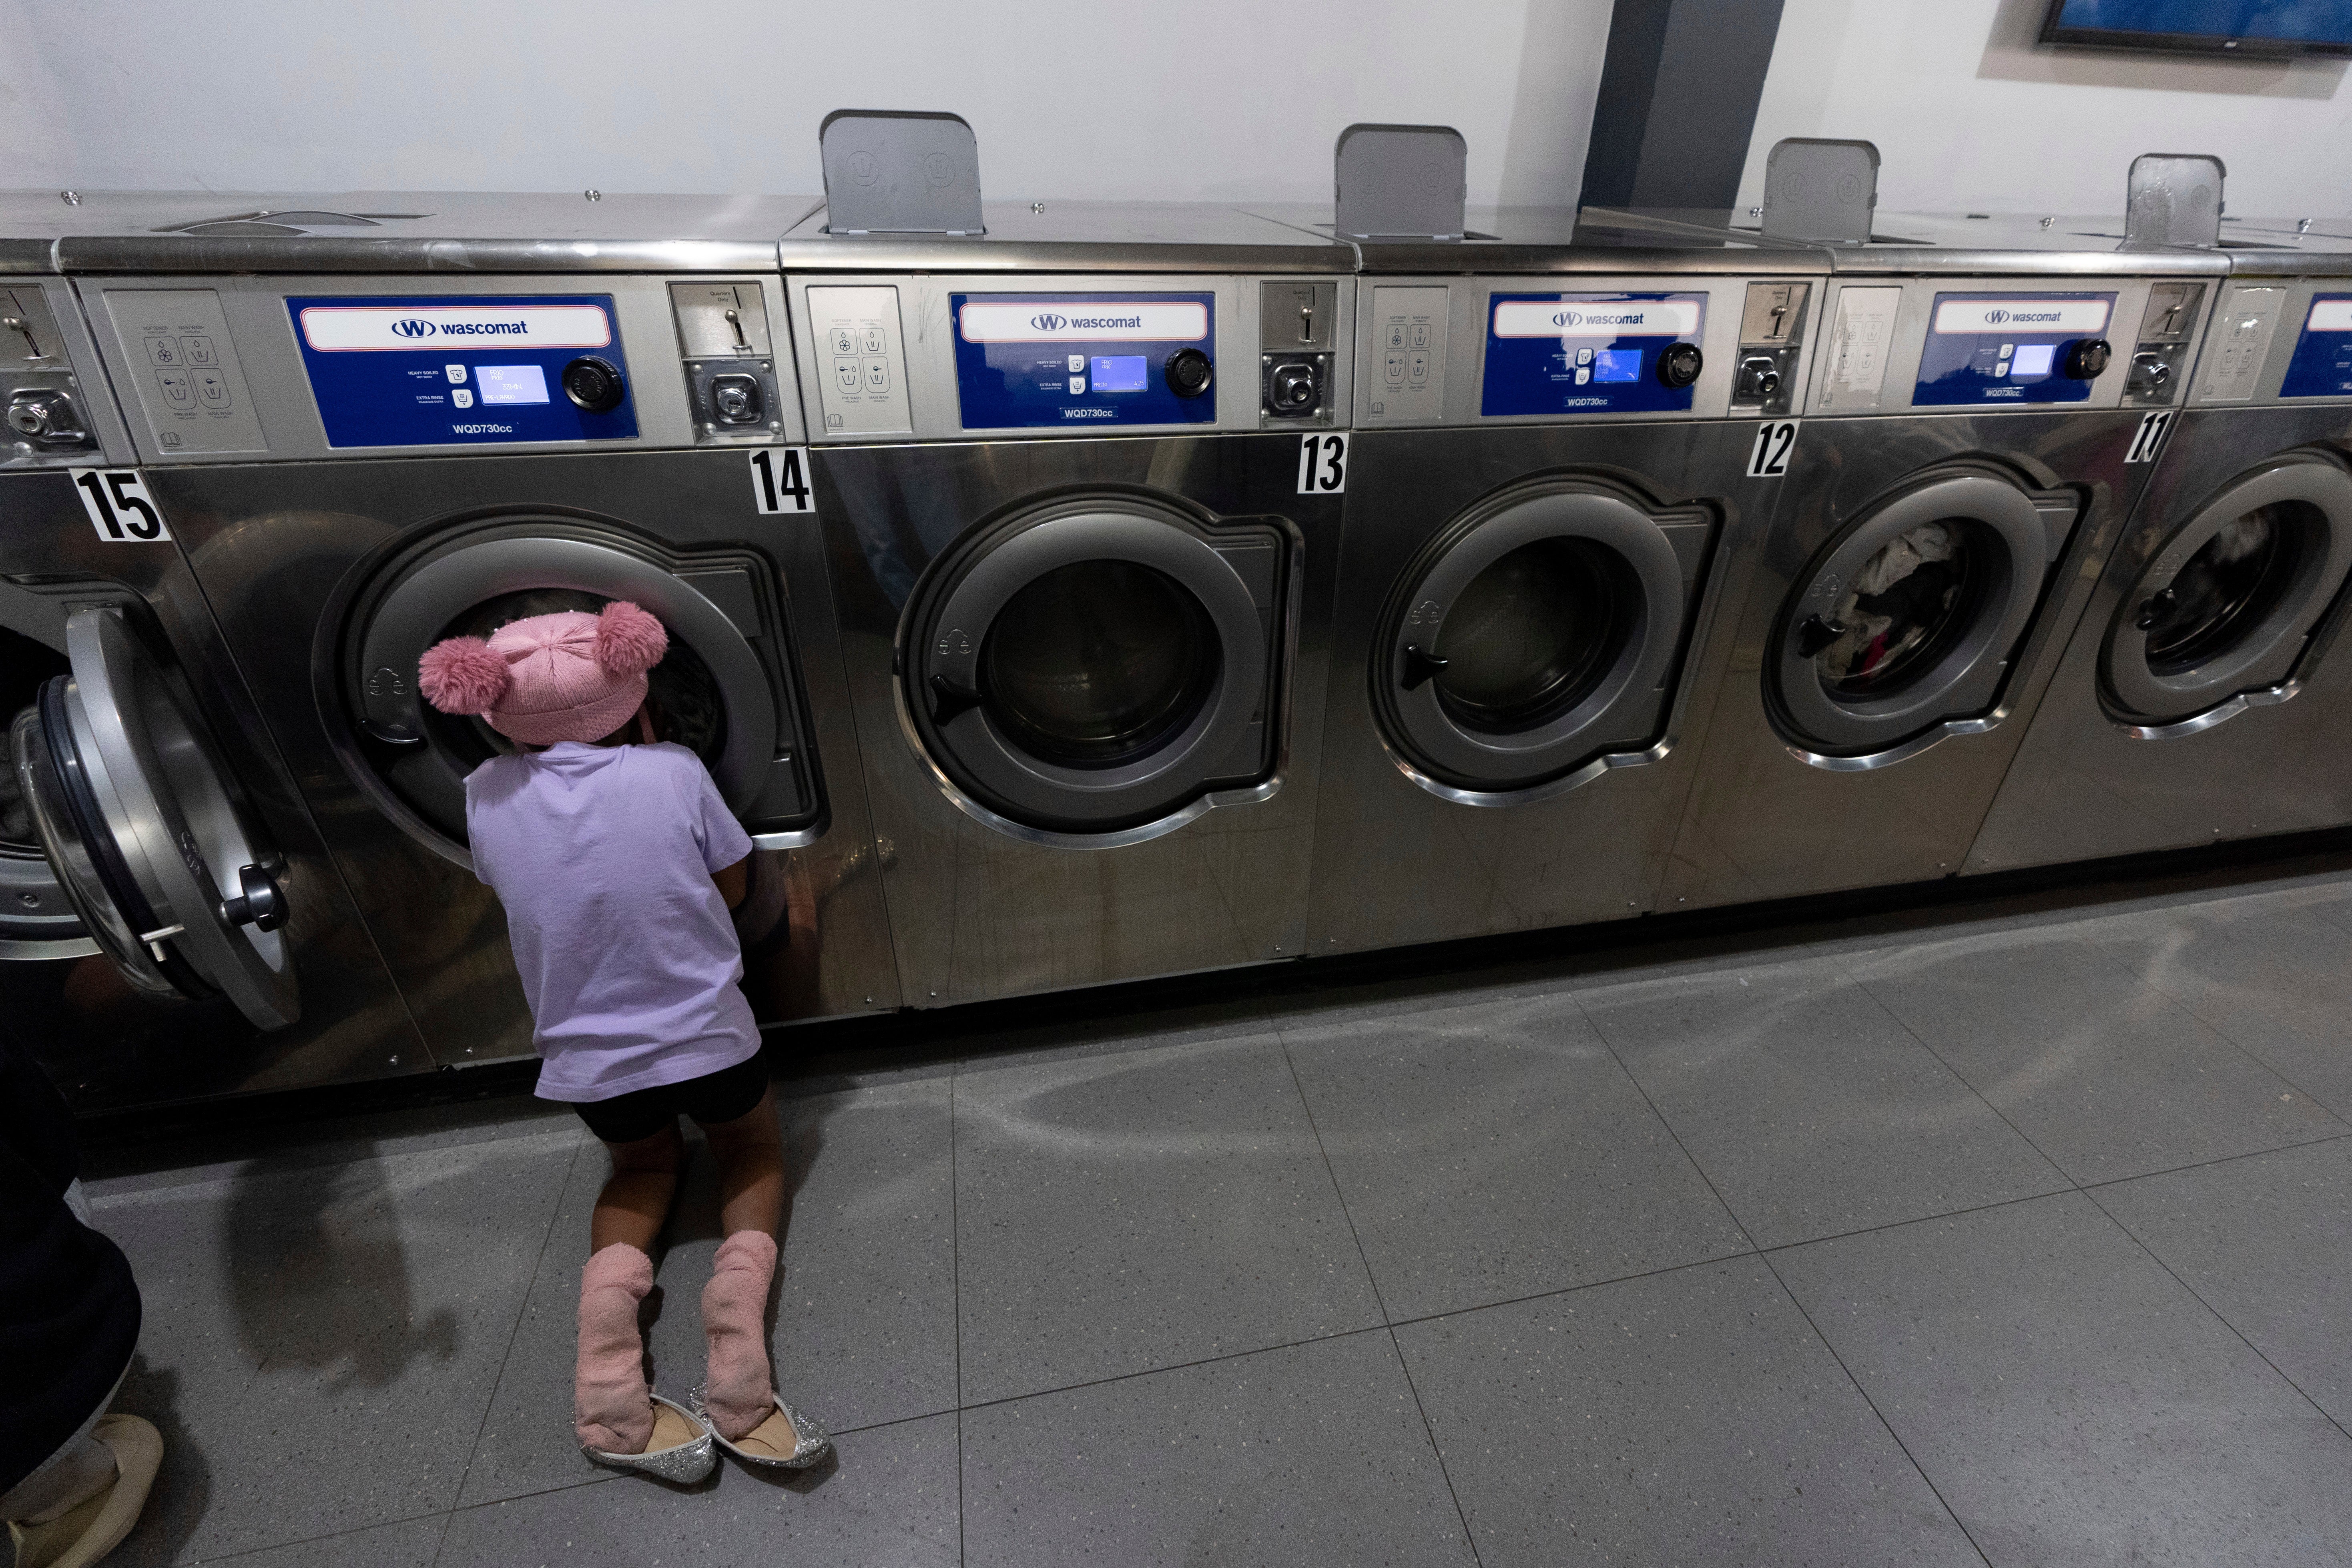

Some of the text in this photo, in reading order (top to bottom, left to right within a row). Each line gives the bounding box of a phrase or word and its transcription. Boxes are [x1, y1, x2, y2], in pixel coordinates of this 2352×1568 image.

[1071, 316, 1141, 328] wascomat
[1586, 313, 1644, 324] wascomat
[2013, 312, 2061, 321] wascomat
[441, 321, 528, 335] wascomat
[1568, 398, 1607, 406] WQD730cc
[1064, 409, 1113, 418] WQD730cc
[452, 424, 512, 434] WQD730cc
[2131, 413, 2171, 460] 11
[1753, 423, 1796, 474] 12
[1304, 436, 1344, 492] 13
[752, 450, 810, 511] 14
[76, 472, 161, 540] 15
